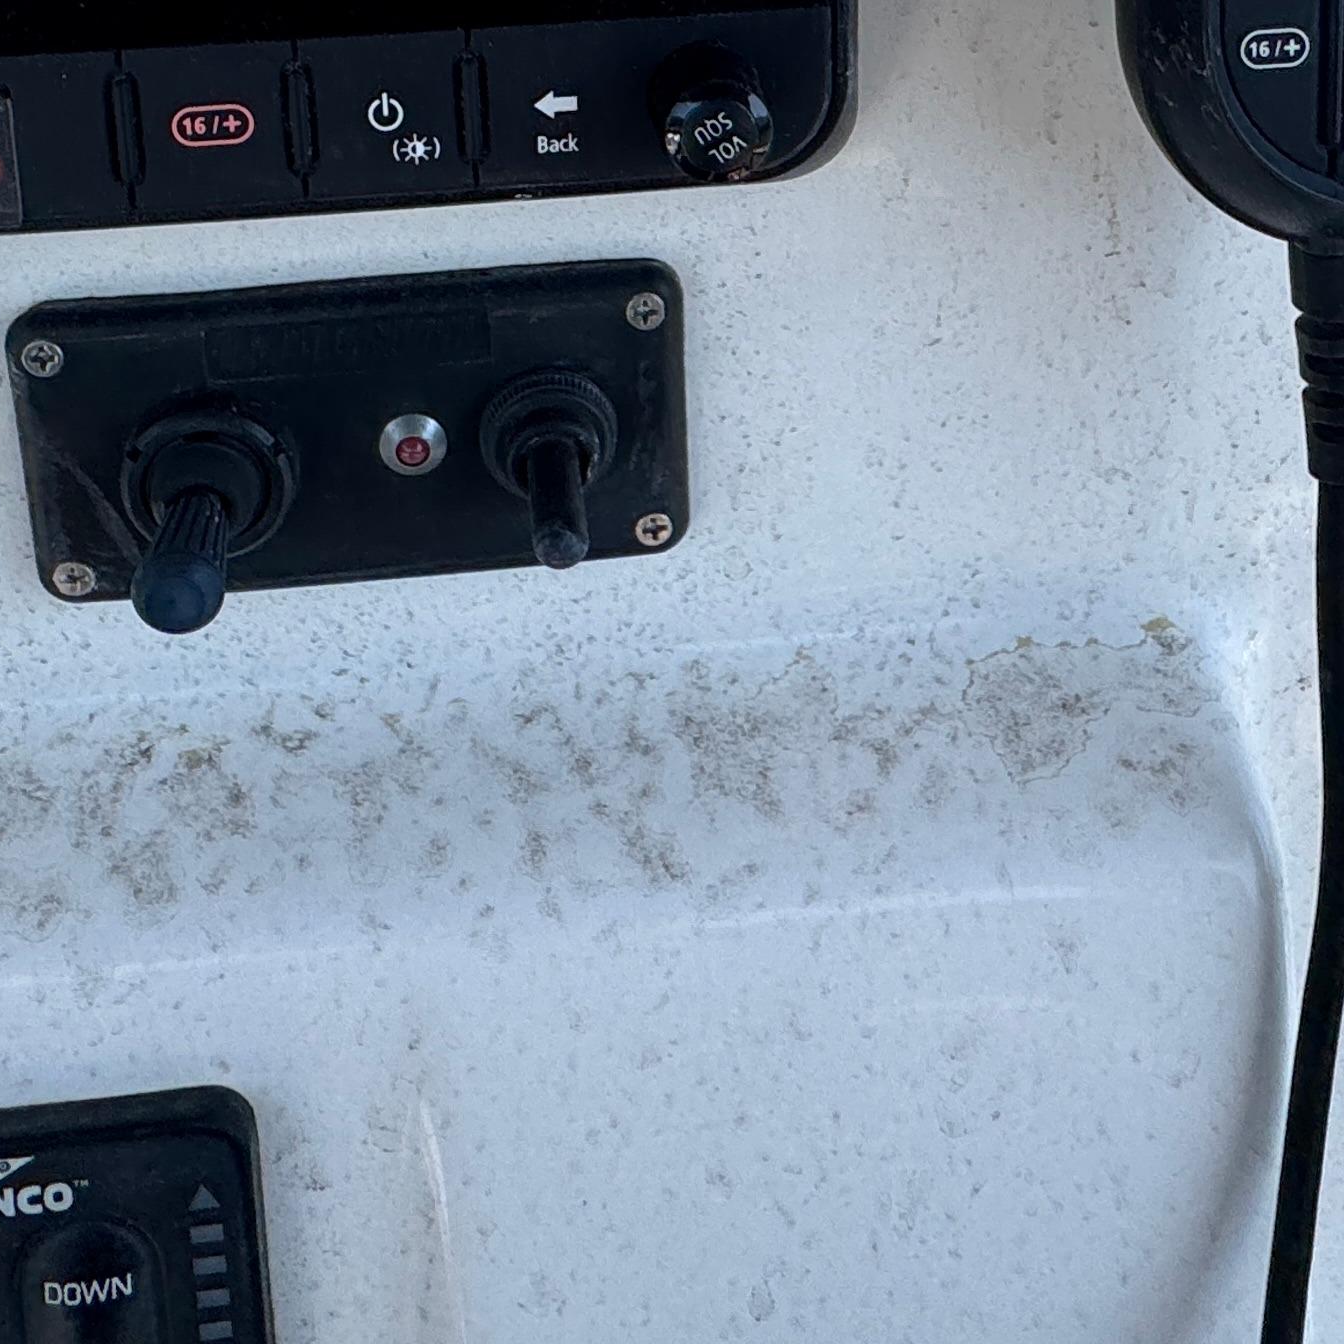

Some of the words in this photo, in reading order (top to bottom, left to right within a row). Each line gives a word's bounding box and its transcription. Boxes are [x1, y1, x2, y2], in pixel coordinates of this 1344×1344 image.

[537, 132, 580, 154] Back
[694, 111, 733, 145] SQU
[707, 135, 748, 164] VOL
[45, 1272, 133, 1307] DOWN
